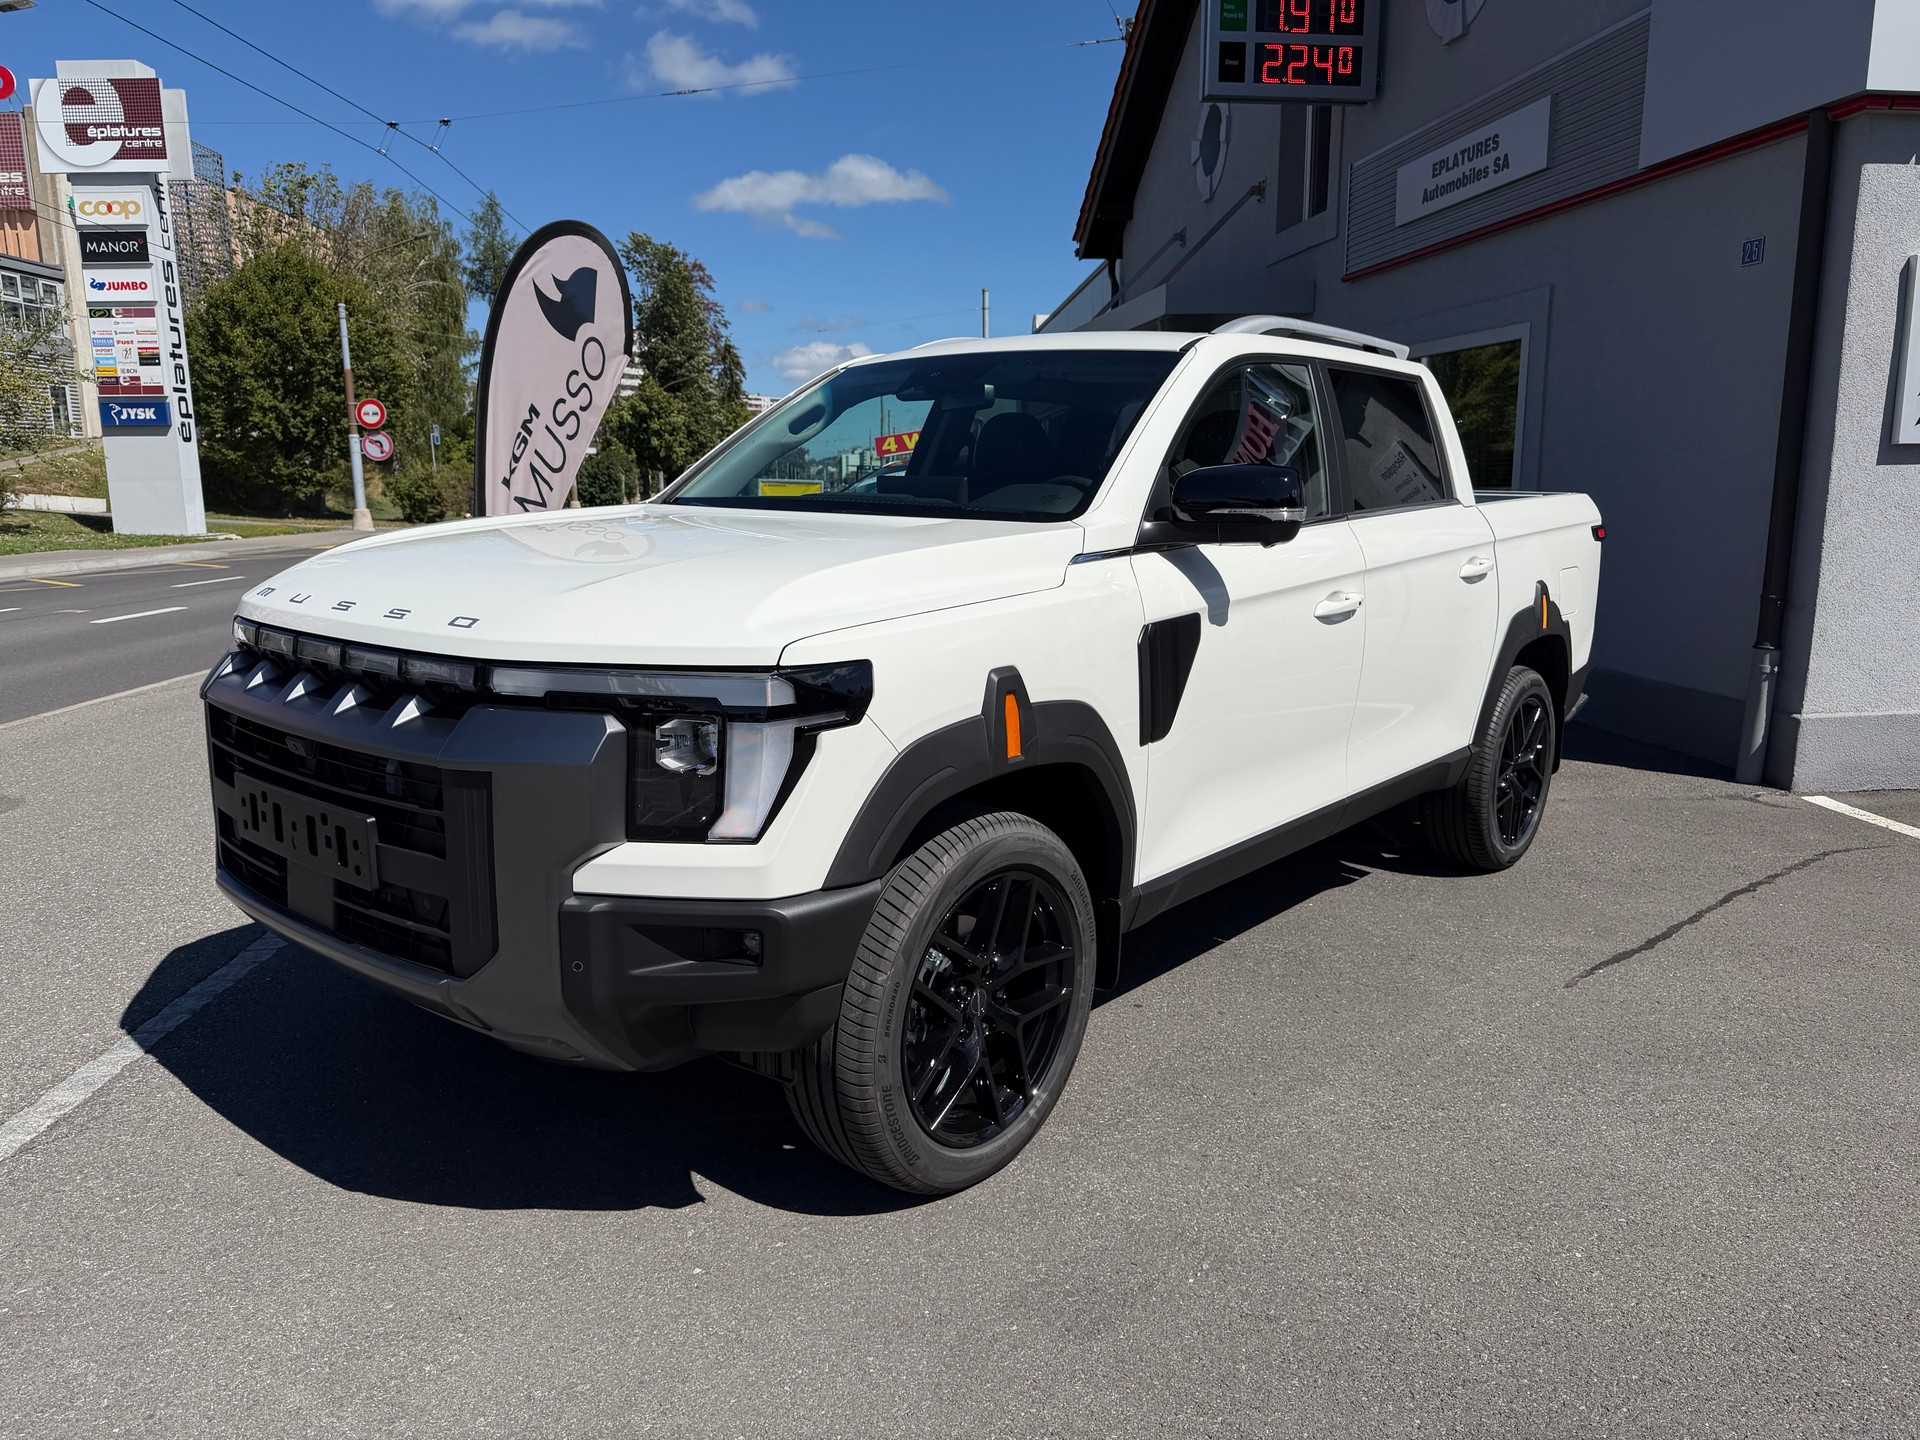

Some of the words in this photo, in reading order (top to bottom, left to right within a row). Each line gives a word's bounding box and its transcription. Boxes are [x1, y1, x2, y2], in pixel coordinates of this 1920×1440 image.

[87, 125, 162, 140] éplatures
[125, 140, 163, 148] centre
[1431, 133, 1500, 179] EPLATURES
[1422, 165, 1490, 205] Automobiles
[1492, 152, 1511, 175] SA
[79, 200, 141, 220] coop
[86, 240, 140, 253] MANOR
[1744, 240, 1760, 262] 25
[106, 280, 148, 291] JUMBO
[162, 259, 194, 444] éplatures
[120, 407, 157, 420] JYSK
[513, 336, 606, 512] MUSSO
[501, 403, 541, 490] KGM
[256, 587, 480, 629] MUSSO
[884, 981, 900, 1038] 255/50R20
[881, 1083, 921, 1168] BRIDGESTONE
